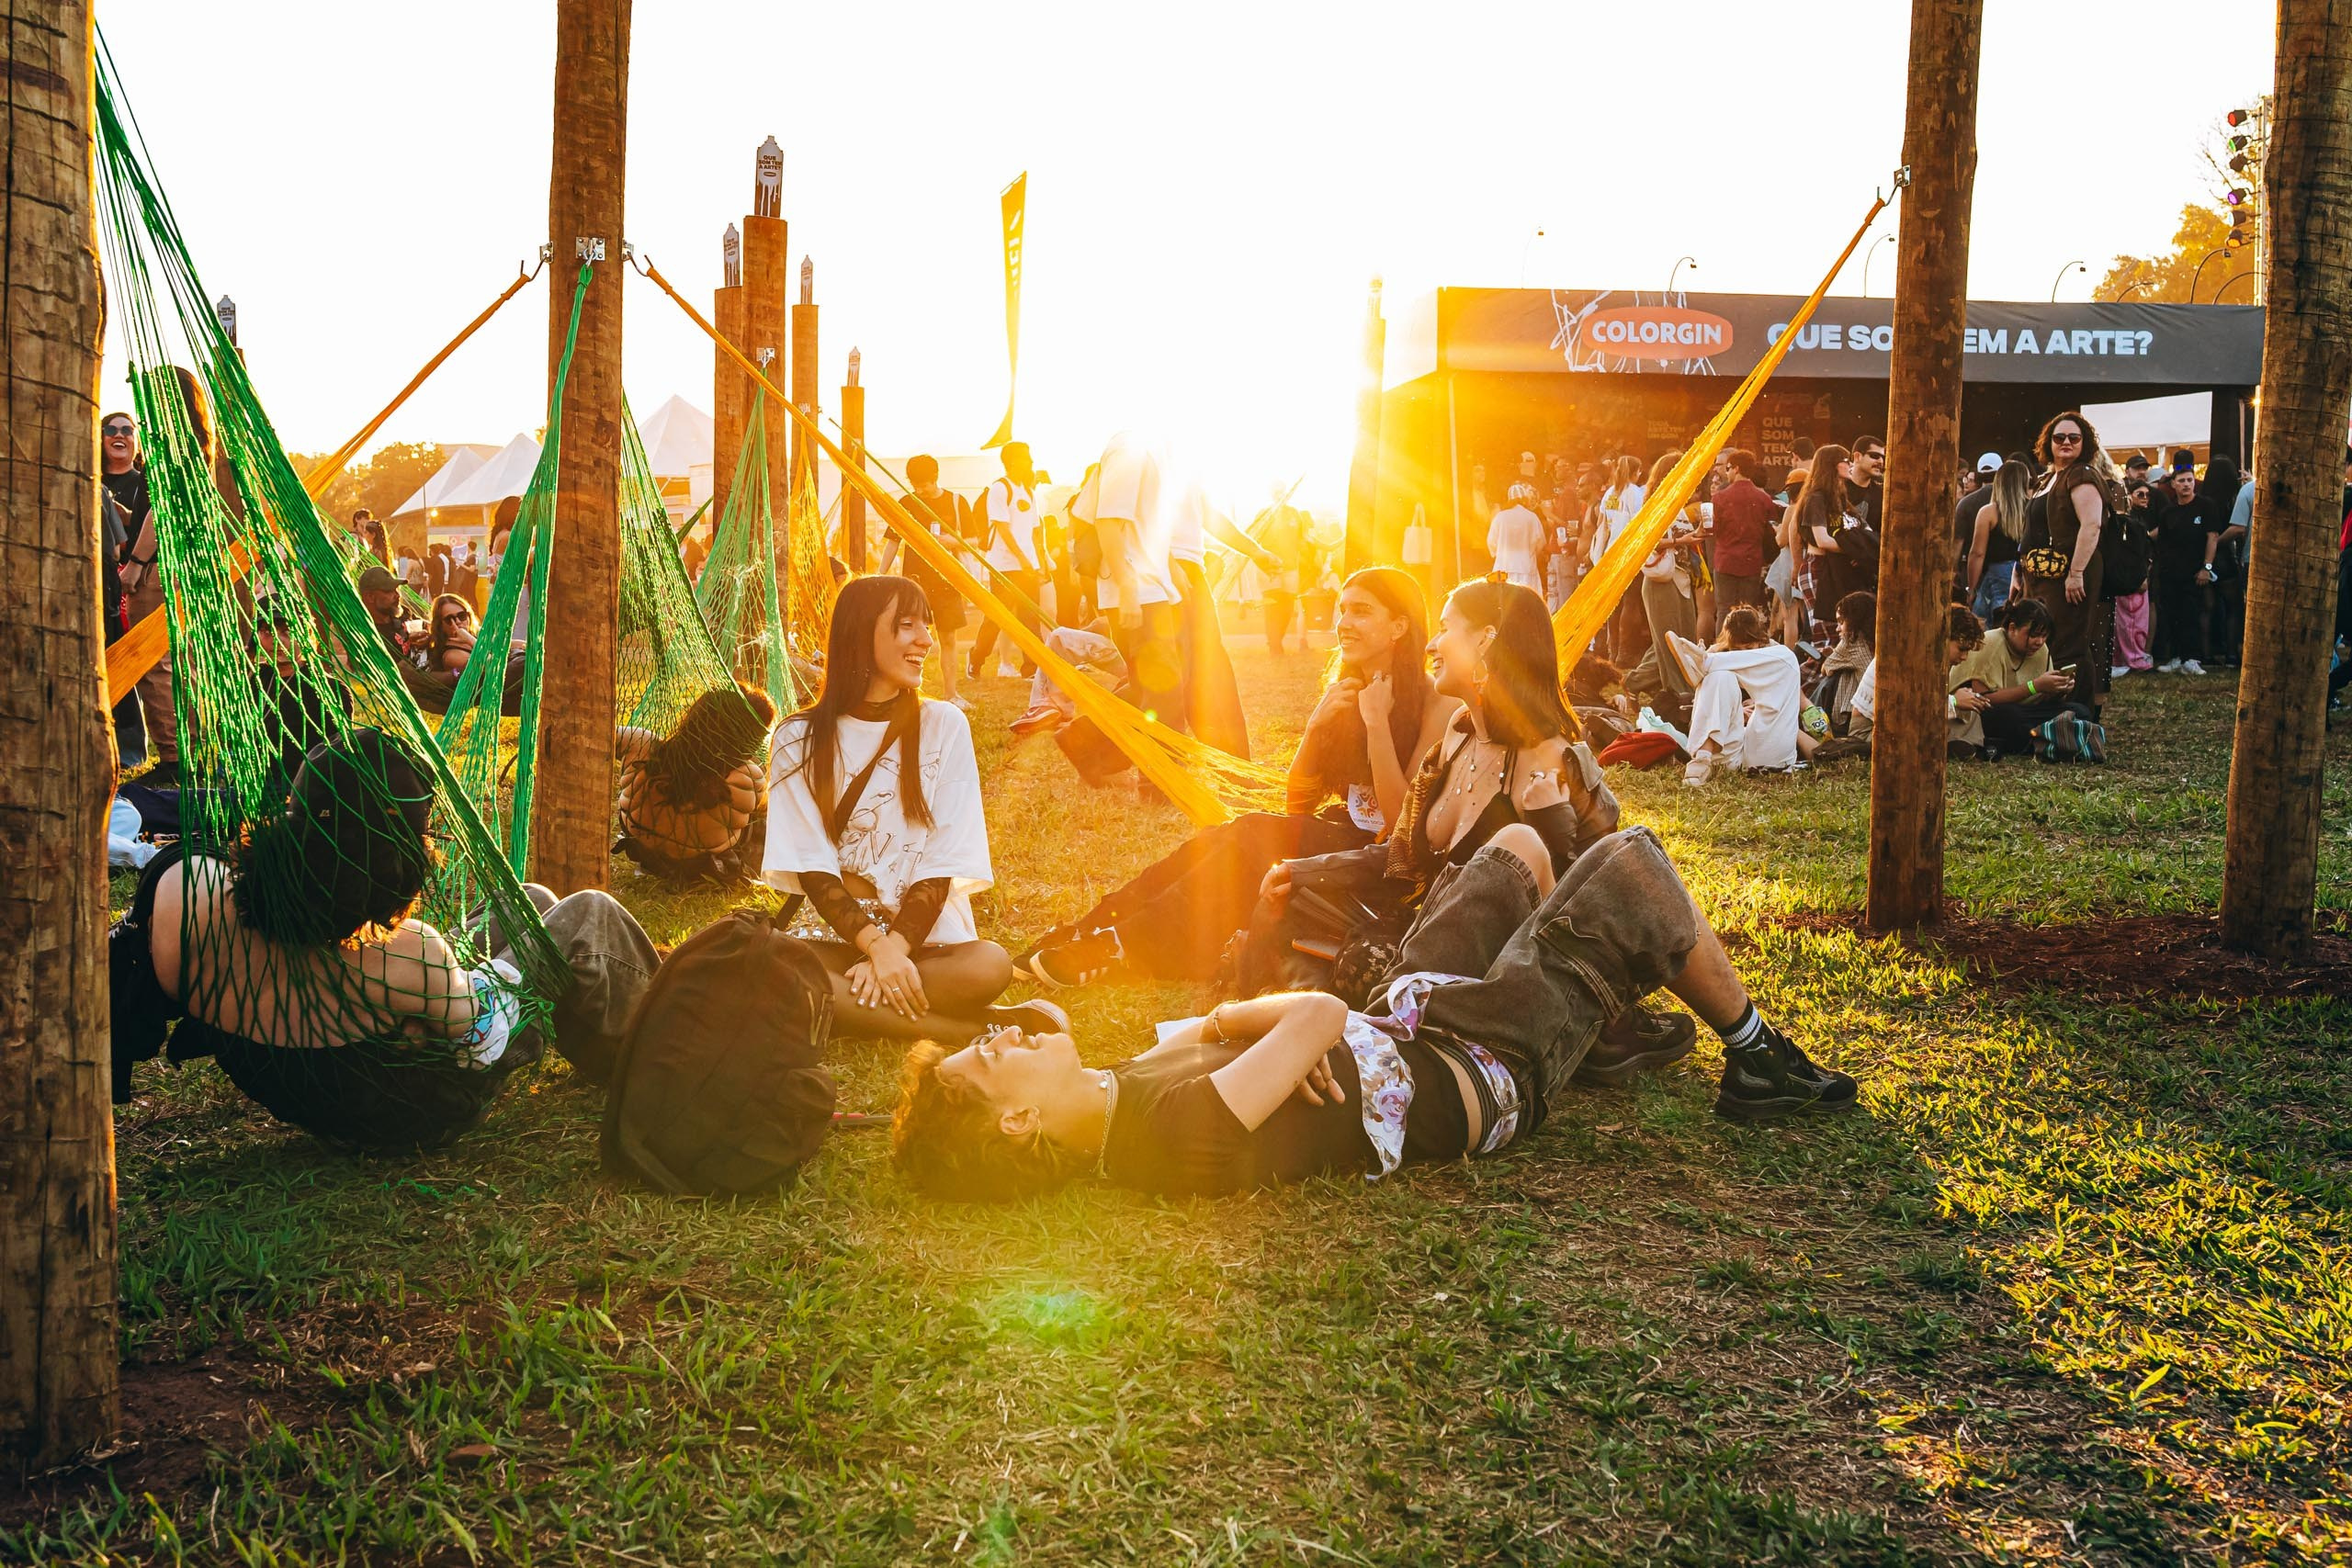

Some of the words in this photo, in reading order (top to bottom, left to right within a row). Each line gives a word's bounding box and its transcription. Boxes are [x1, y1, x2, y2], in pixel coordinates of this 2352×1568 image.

[1592, 321, 1722, 344] COLORGIN
[1848, 325, 1894, 351] SO
[1963, 328, 2007, 354] EM
[2014, 330, 2040, 354] A
[2044, 330, 2154, 355] ARTE?
[1762, 417, 1792, 427] QUE
[1761, 430, 1793, 440] SOM
